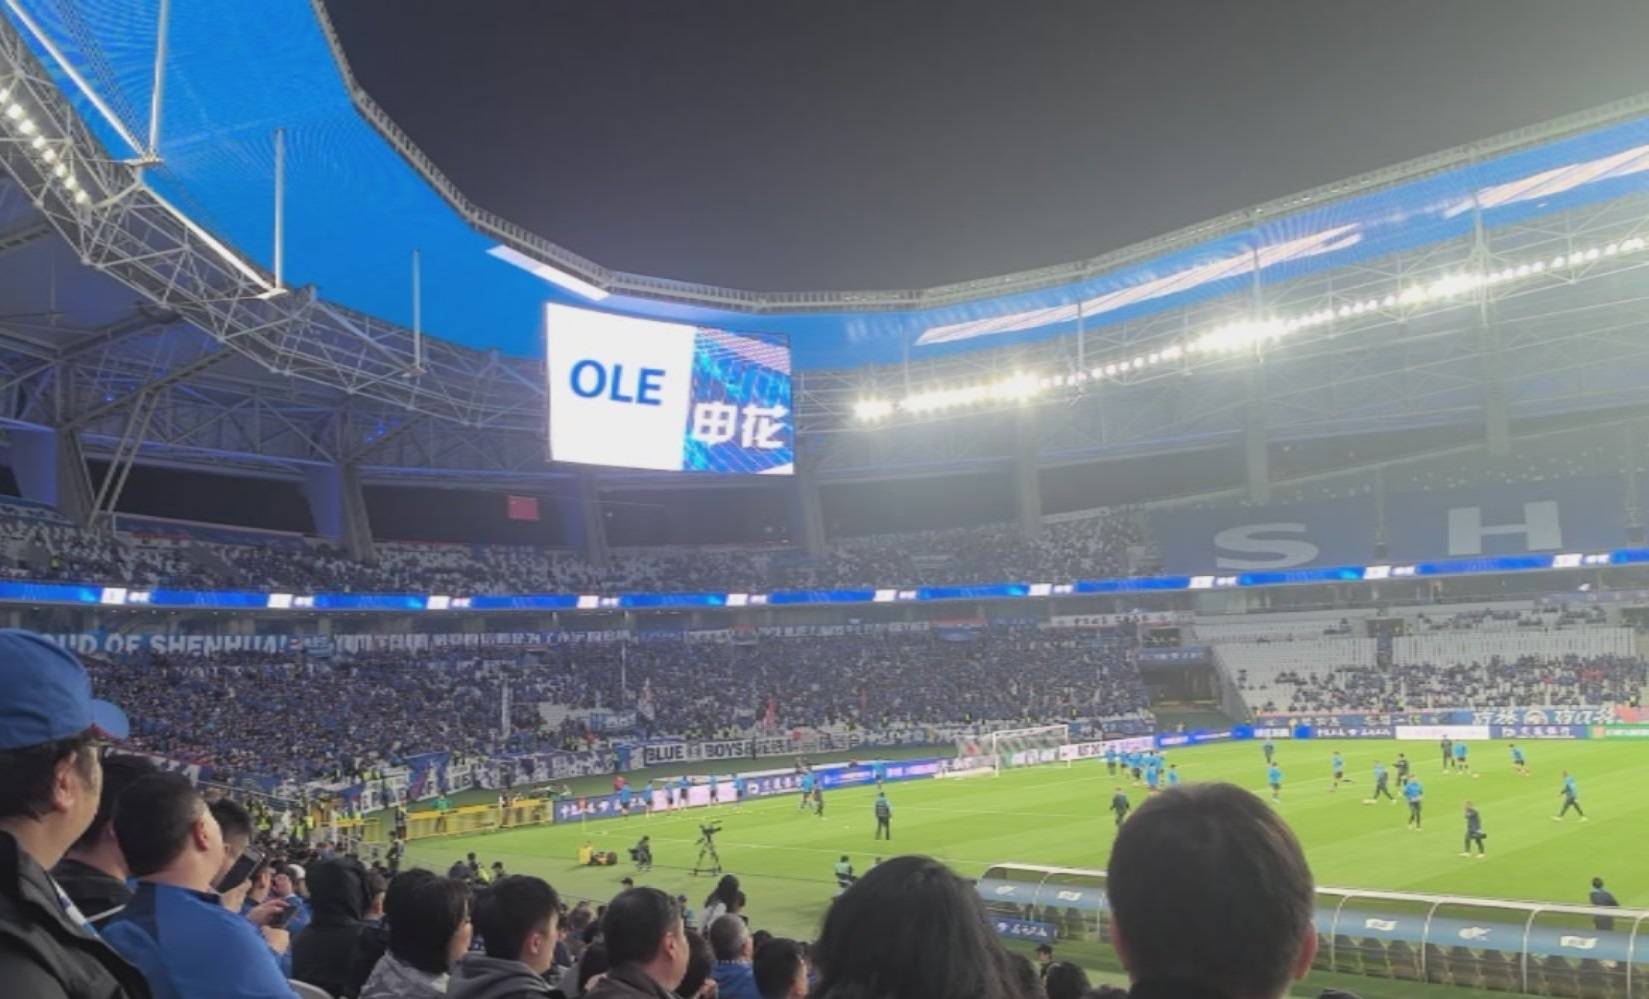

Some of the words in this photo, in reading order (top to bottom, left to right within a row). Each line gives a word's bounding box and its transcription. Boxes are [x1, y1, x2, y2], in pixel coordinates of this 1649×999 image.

[569, 359, 666, 406] OLE
[693, 401, 790, 449] 申花
[1213, 522, 1319, 571] S
[1447, 501, 1563, 556] H
[104, 634, 142, 655] OF
[647, 745, 684, 761] BLUE
[705, 742, 743, 757] BOYS
